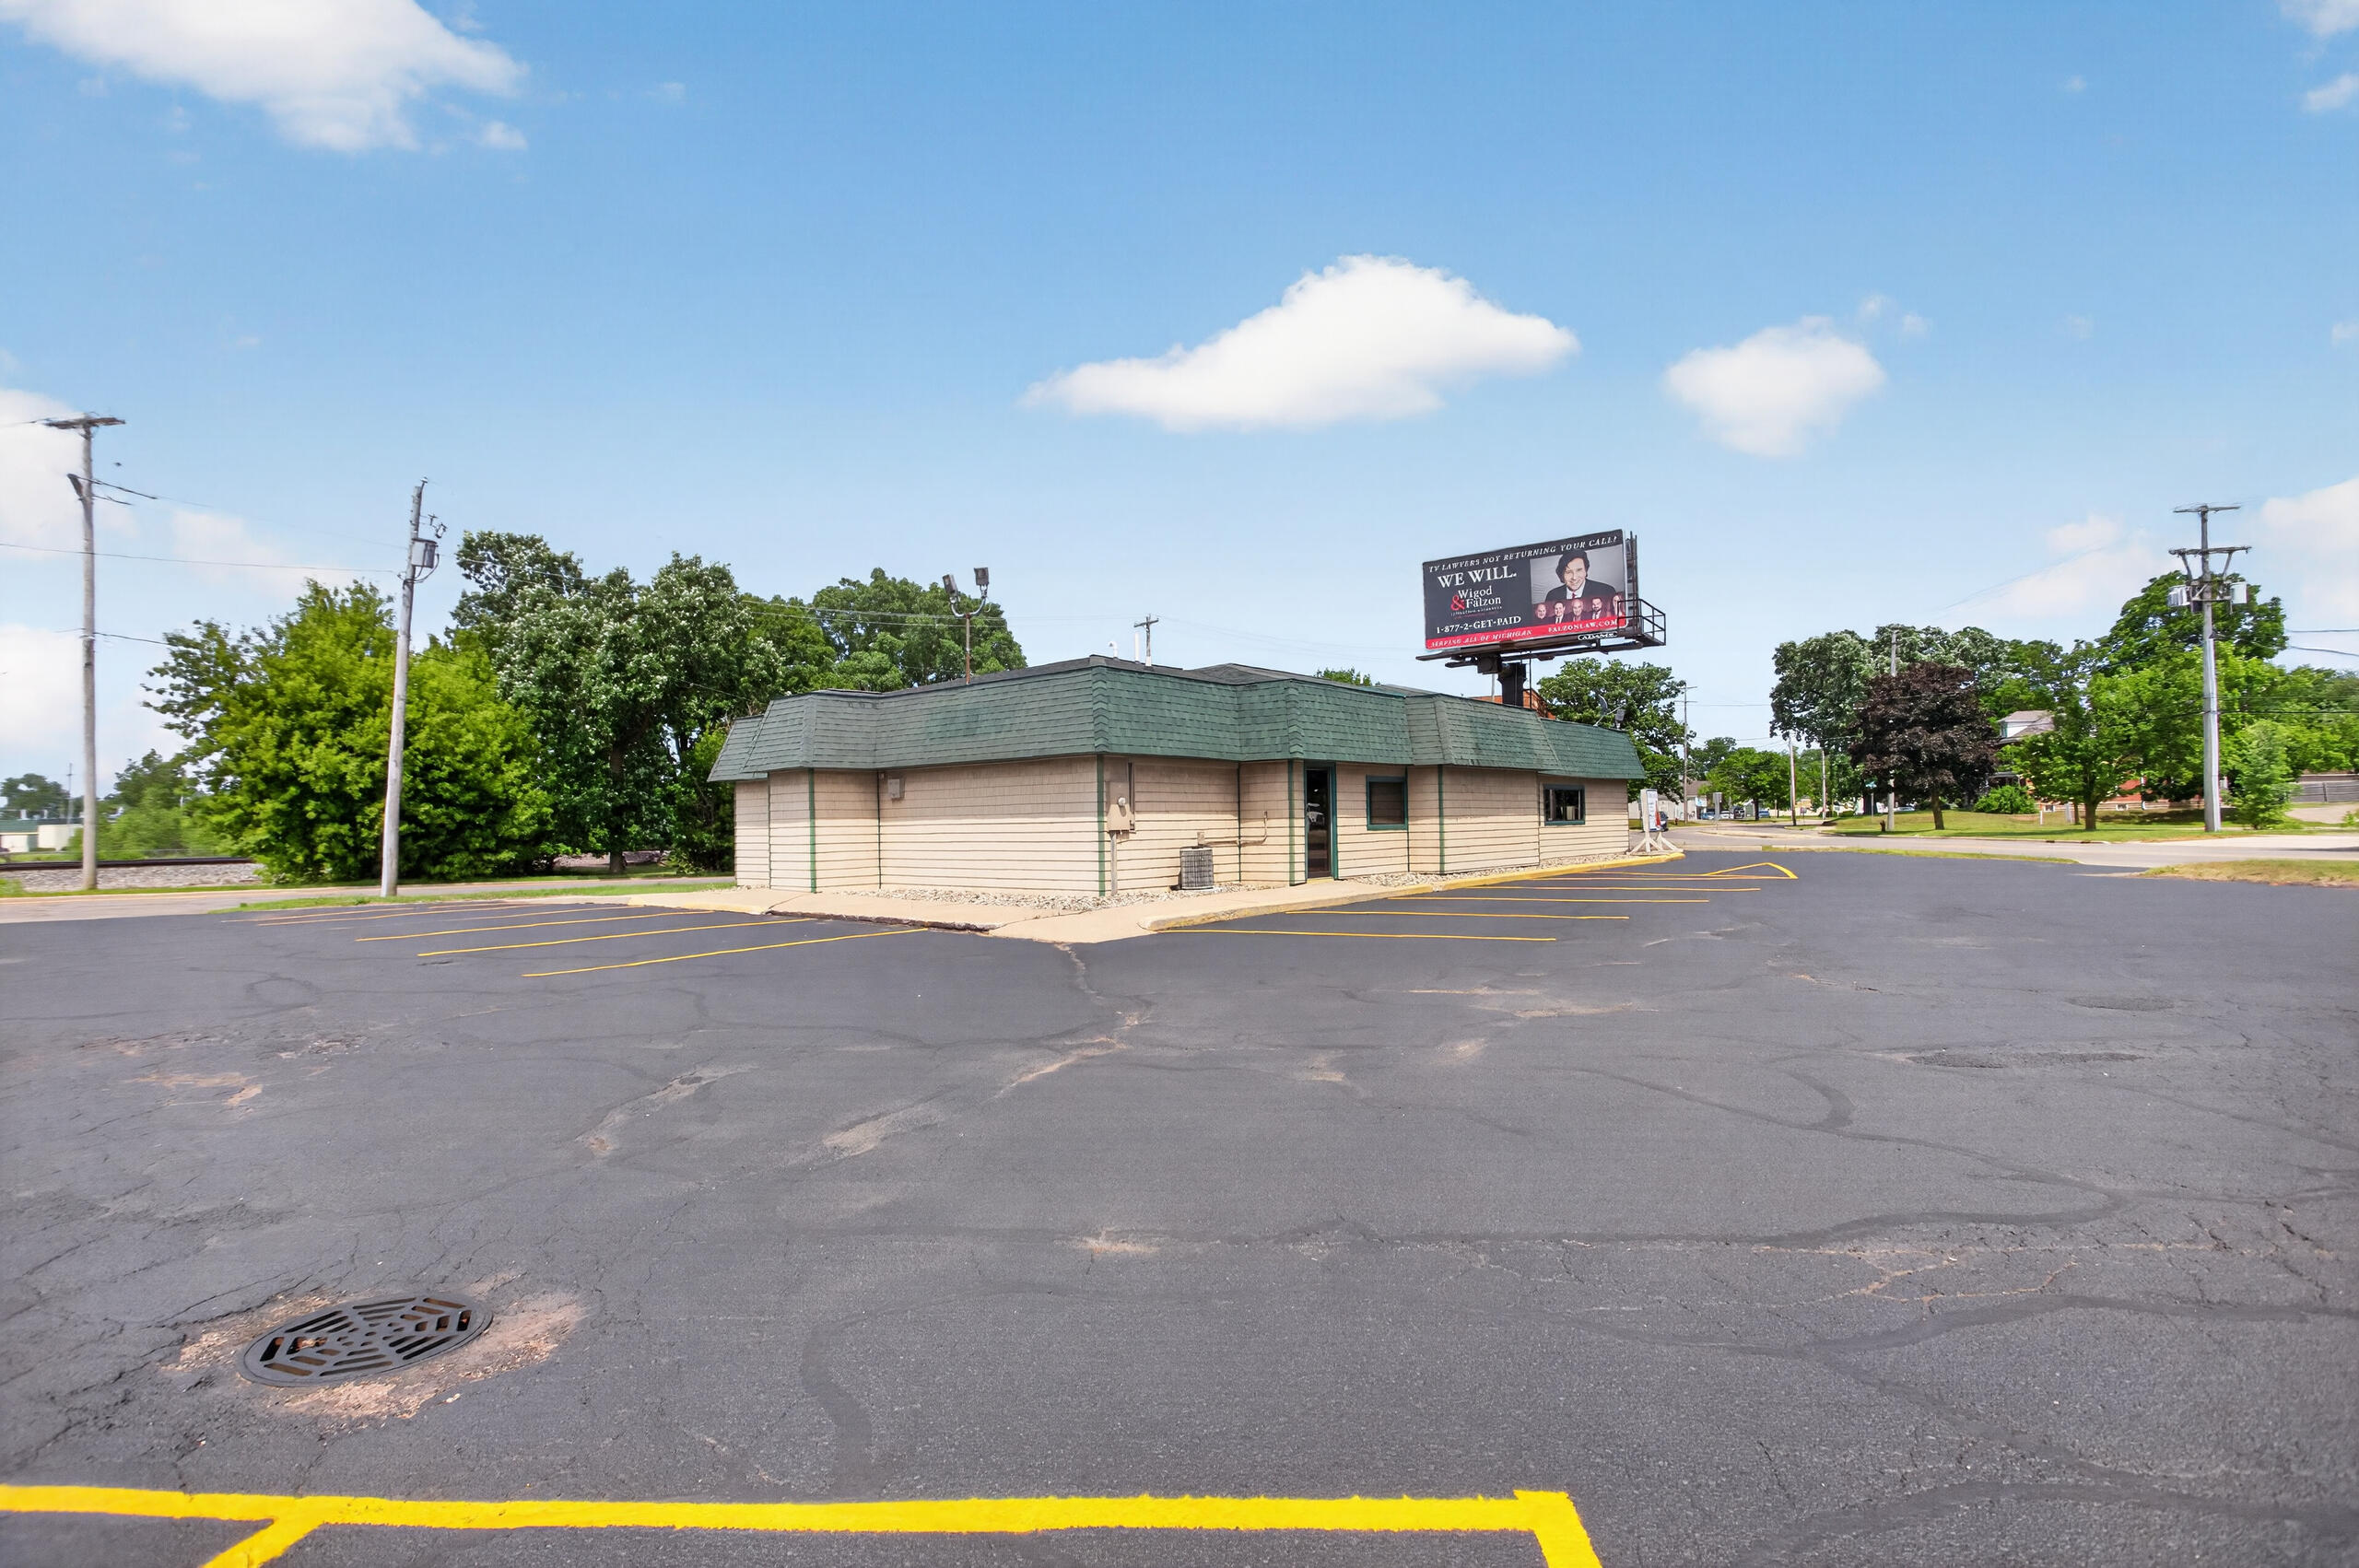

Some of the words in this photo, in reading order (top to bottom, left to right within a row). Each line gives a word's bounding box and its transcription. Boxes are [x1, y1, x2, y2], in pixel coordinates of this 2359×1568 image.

[1429, 565, 1440, 573] TV
[1442, 558, 1480, 570] LAWYERS
[1483, 556, 1501, 564] NOT
[1503, 545, 1556, 561] RETURNING
[1560, 541, 1586, 552] YOUR
[1438, 572, 1465, 589] WE
[1468, 565, 1517, 583] WILL.
[1458, 585, 1493, 600] Wigod
[1450, 594, 1465, 611] &
[1465, 596, 1502, 609] Falzon
[1437, 615, 1522, 634] 1-877-2-GET-PAID
[1548, 619, 1618, 633] FALZONLAW.COM
[1480, 634, 1490, 642] OF
[1492, 629, 1533, 640] MICHIGAN
